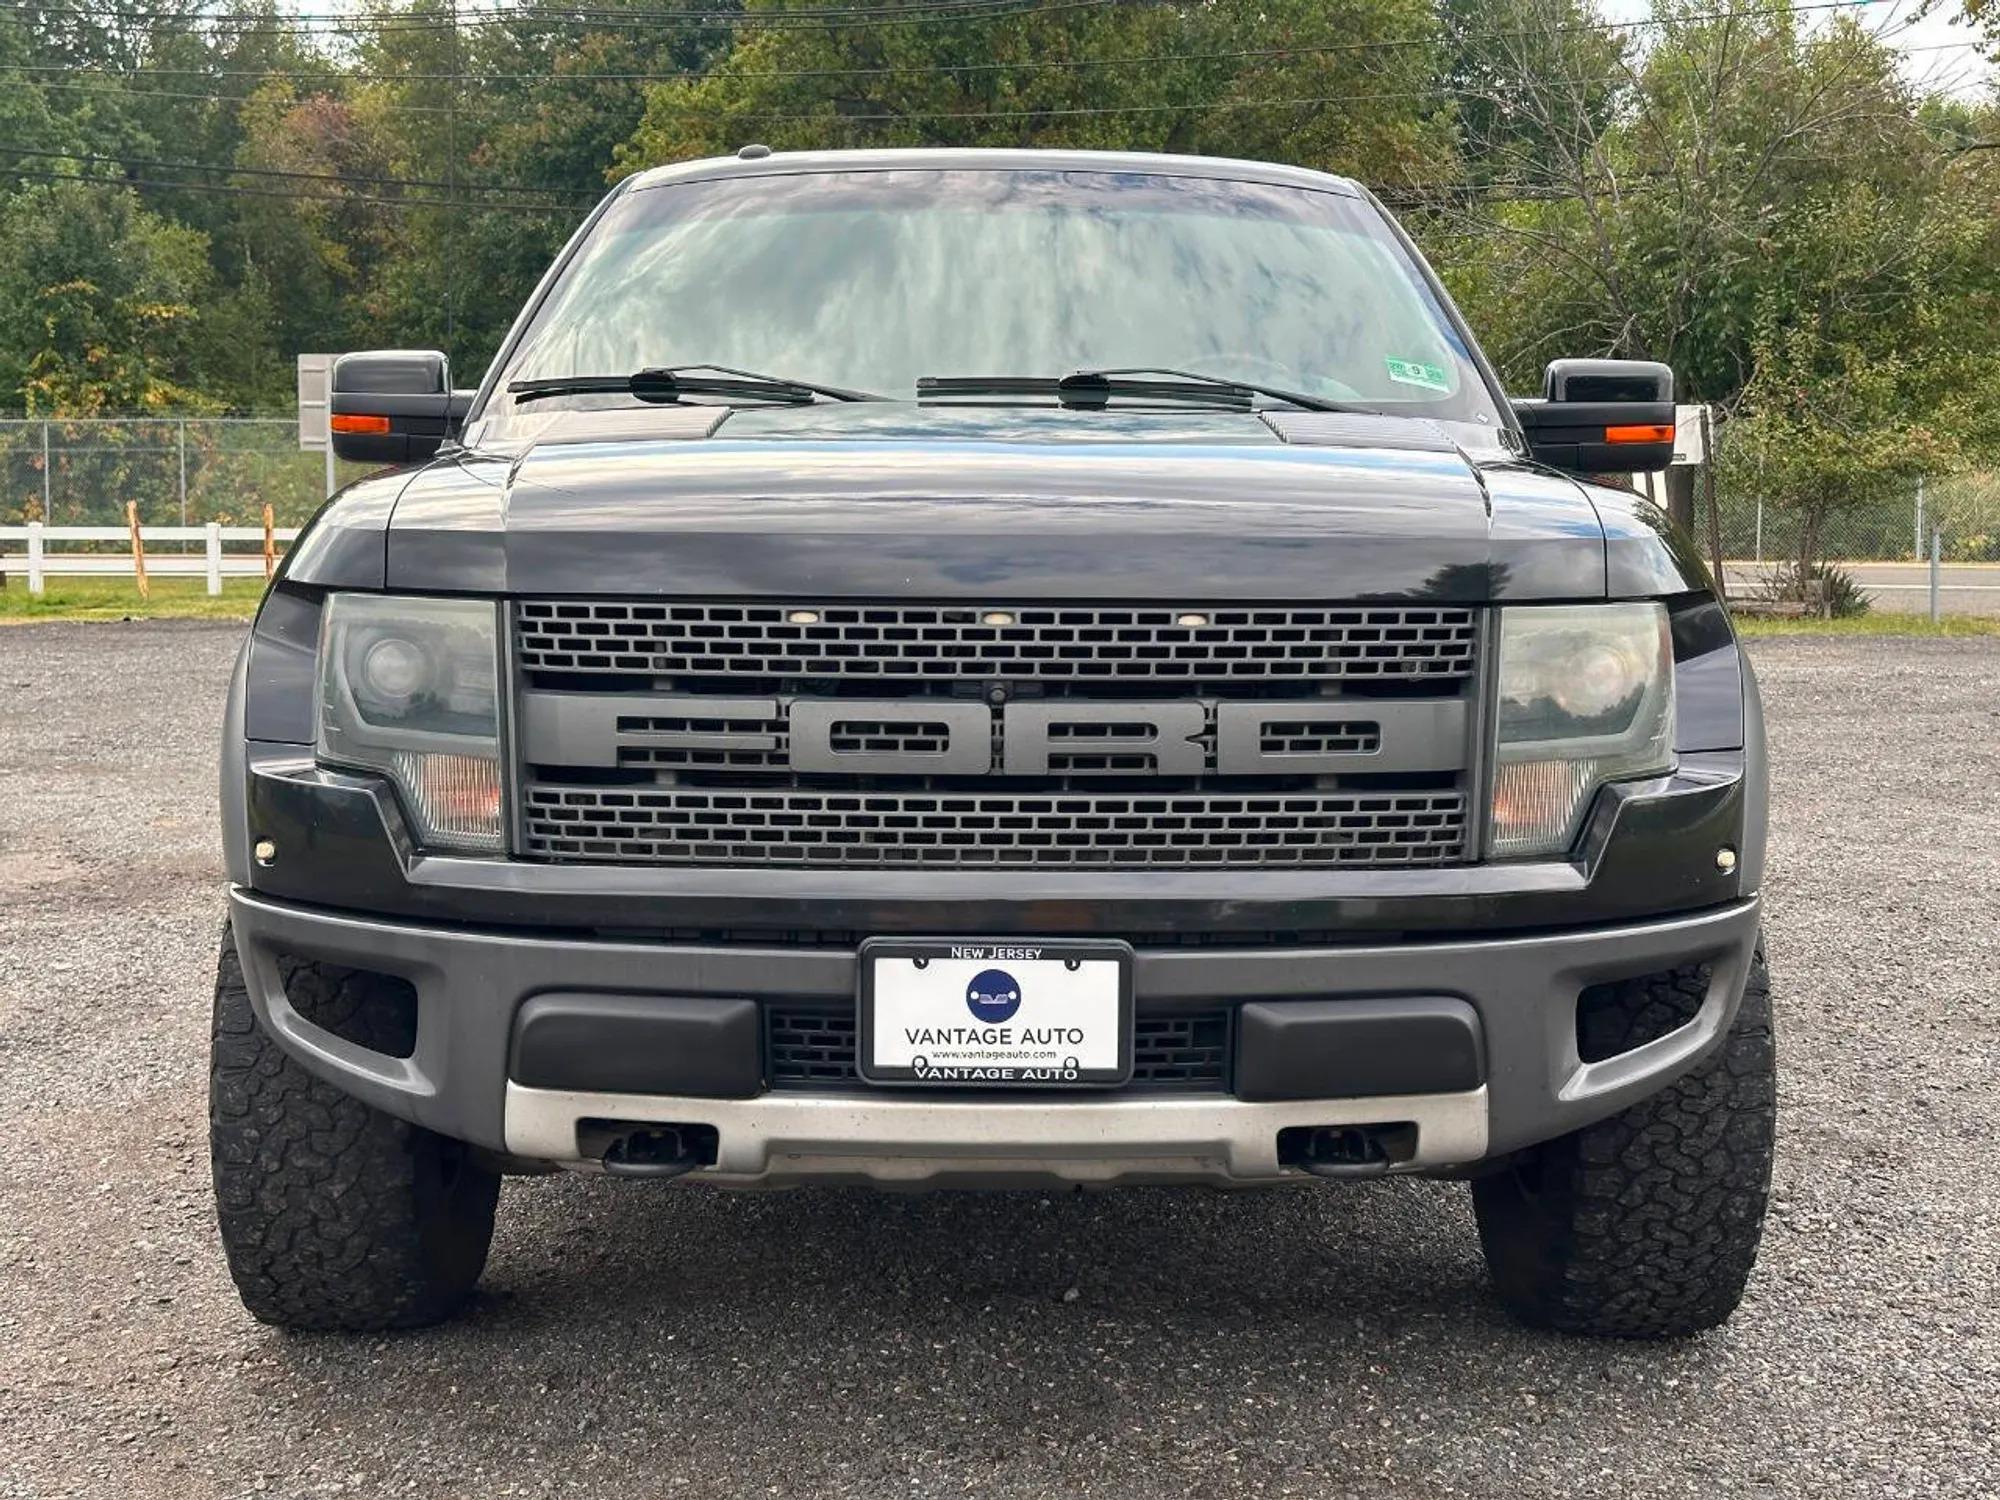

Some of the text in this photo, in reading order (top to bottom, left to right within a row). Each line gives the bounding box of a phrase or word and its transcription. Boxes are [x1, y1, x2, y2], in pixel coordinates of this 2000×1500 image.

[525, 693, 1467, 777] FORD
[950, 946, 1042, 960] NEW JERSEY
[905, 1028, 1084, 1045] VANTAGE AUTO
[932, 1050, 1057, 1060] www.vantageauto.com
[914, 1067, 1079, 1081] VANTAGE AUTO
